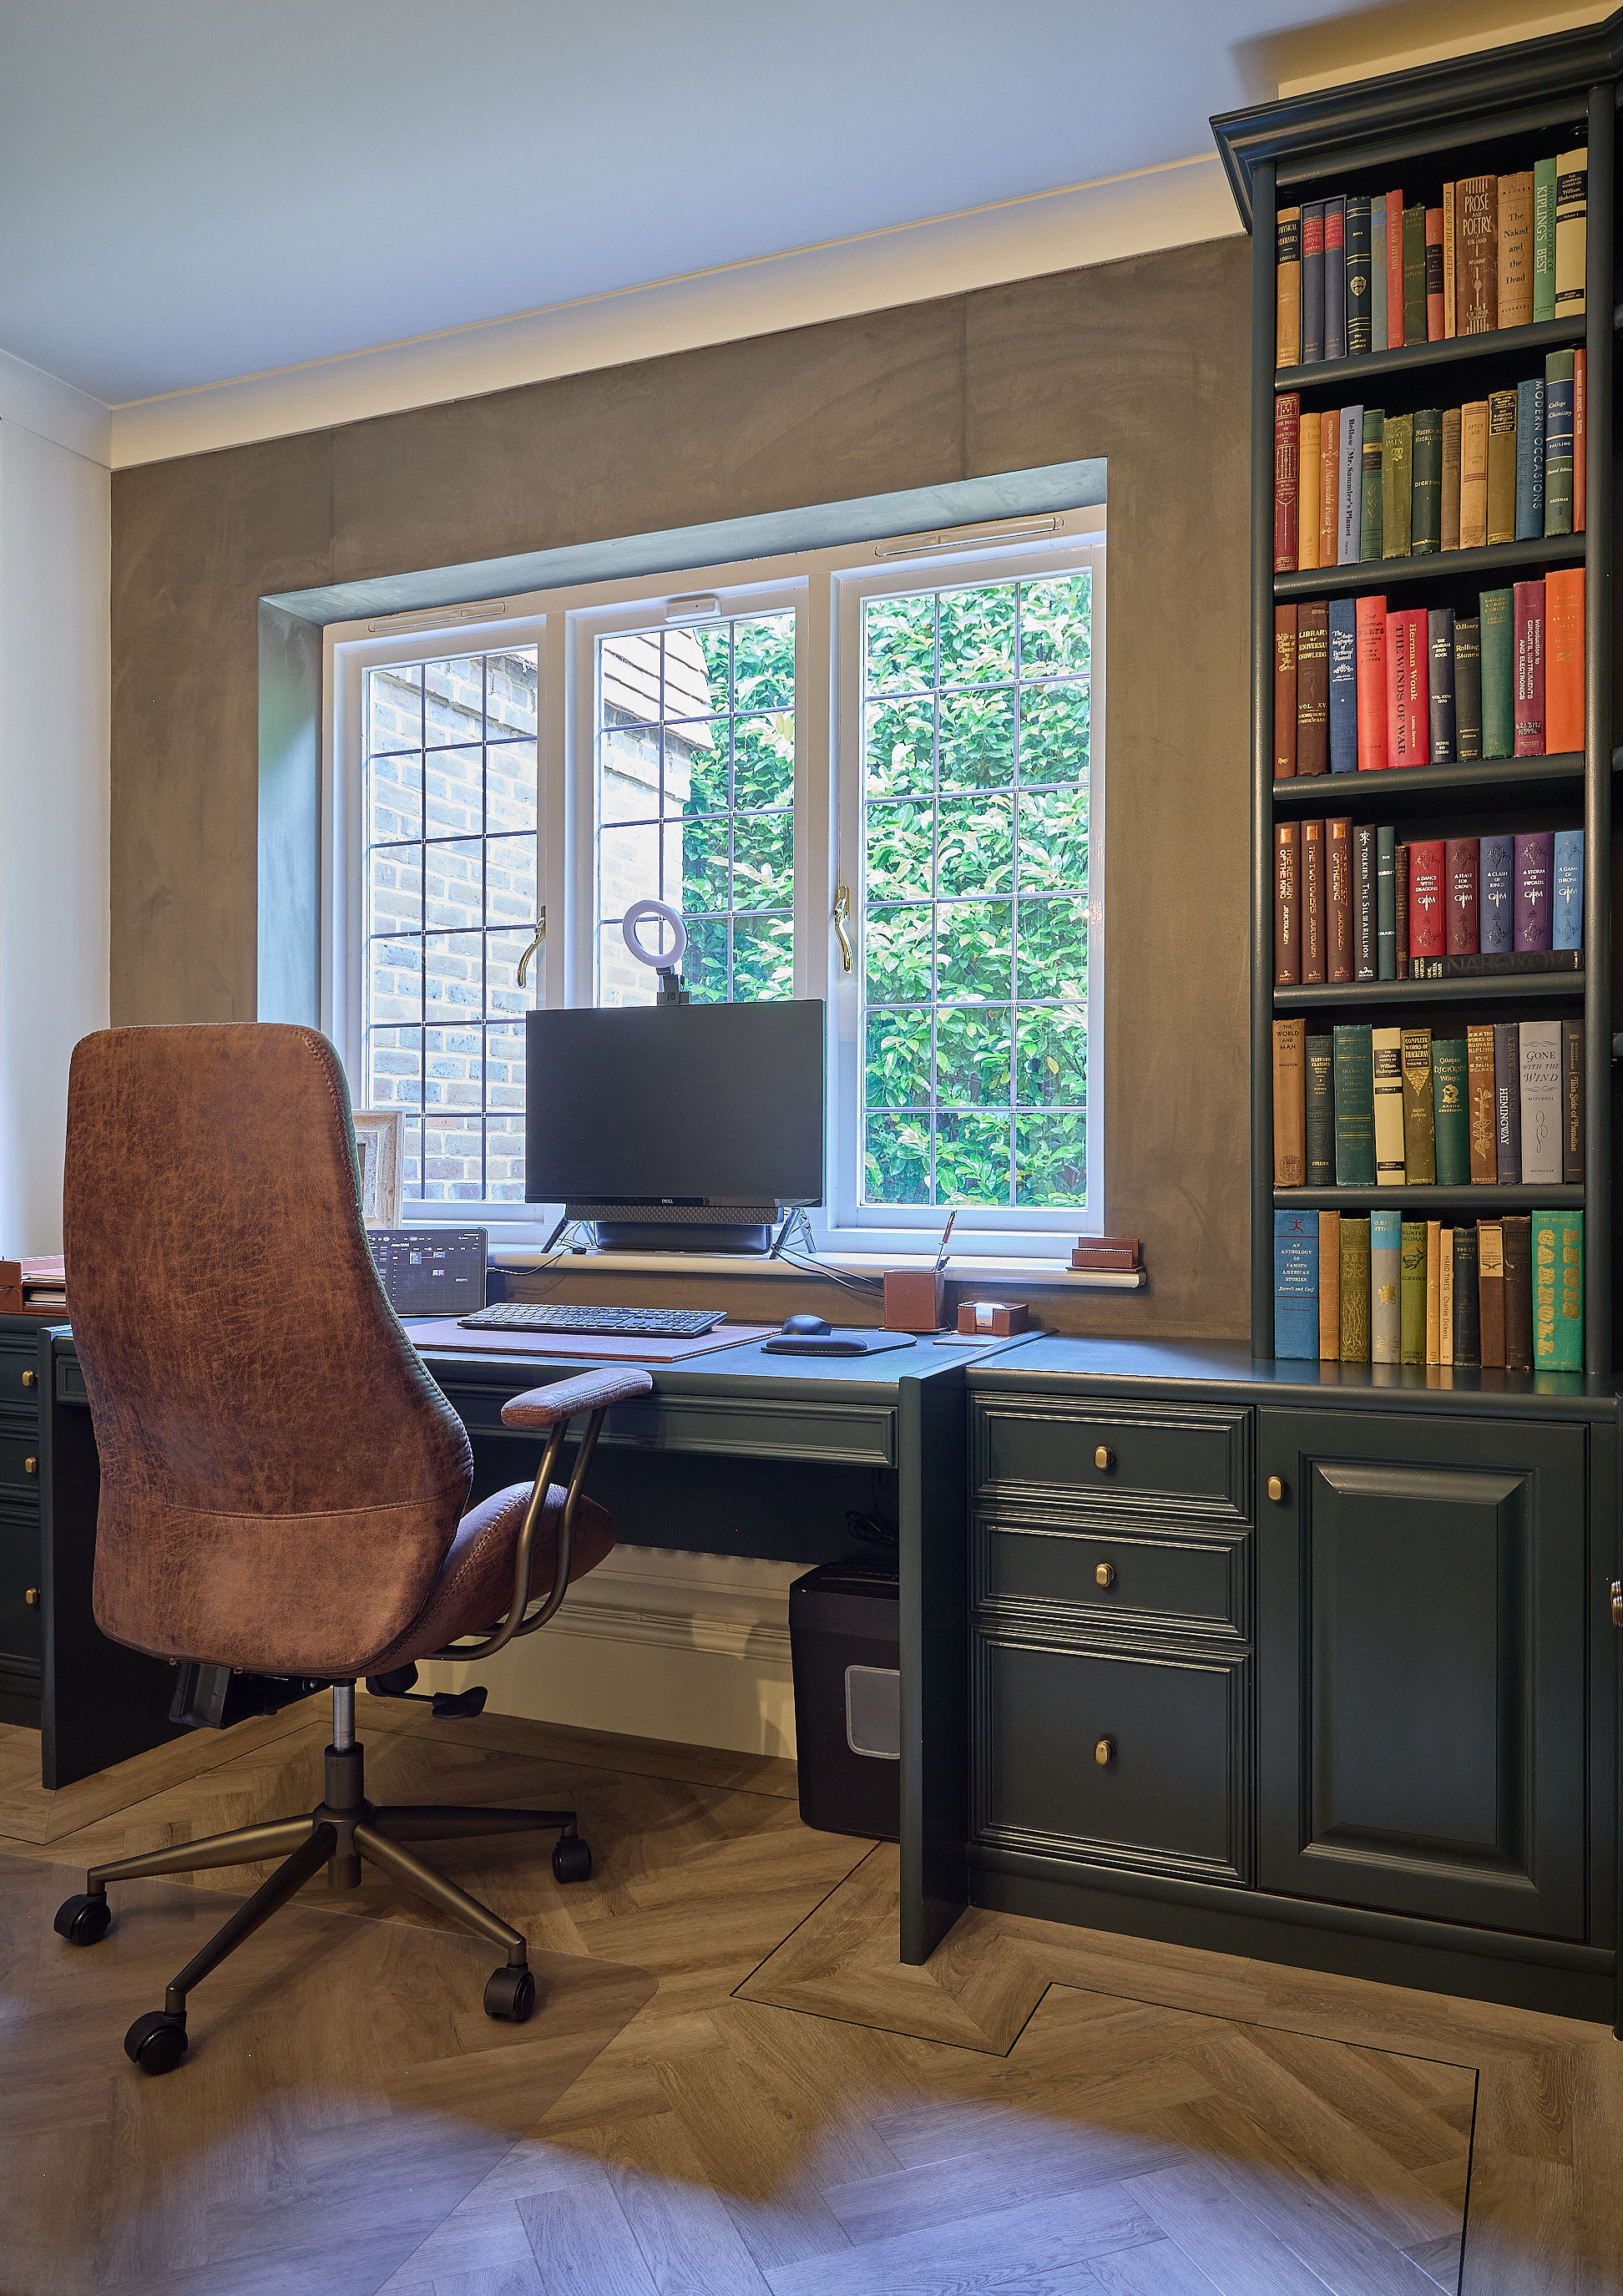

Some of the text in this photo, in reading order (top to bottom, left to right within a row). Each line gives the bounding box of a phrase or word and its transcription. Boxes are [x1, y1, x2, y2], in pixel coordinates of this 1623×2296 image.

[1558, 192, 1585, 202] Shakespeare
[1465, 194, 1489, 214] PROSE
[1446, 216, 1452, 225] OF
[1463, 215, 1491, 236] POETRY
[1278, 224, 1297, 234] PHYSICAL
[1504, 227, 1528, 238] Naked
[1278, 235, 1297, 246] MECHANICS
[1509, 243, 1523, 252] and
[1537, 249, 1547, 274] BEST
[1547, 262, 1553, 272] OF
[1506, 274, 1524, 284] Dead
[1549, 401, 1566, 409] College
[1533, 381, 1544, 509] MODERN OCCASIONS
[1326, 469, 1334, 504] Moveable
[1299, 630, 1327, 638] LIBRARY
[1396, 624, 1404, 654] THE
[1333, 648, 1353, 656] Bertrand
[1398, 704, 1405, 721] OF
[1398, 724, 1406, 755] WAR
[1280, 850, 1286, 861] OF
[1333, 852, 1339, 865] OF
[1527, 1050, 1555, 1062] GONE
[1508, 1043, 1516, 1082] FAREWELL
[1524, 1074, 1558, 1082] WIND
[1570, 1094, 1579, 1110] Side
[1499, 1088, 1509, 1145] HEMINGWAY
[1563, 1227, 1580, 1319] LEWIS
[1538, 1228, 1555, 1356] CARROLL
